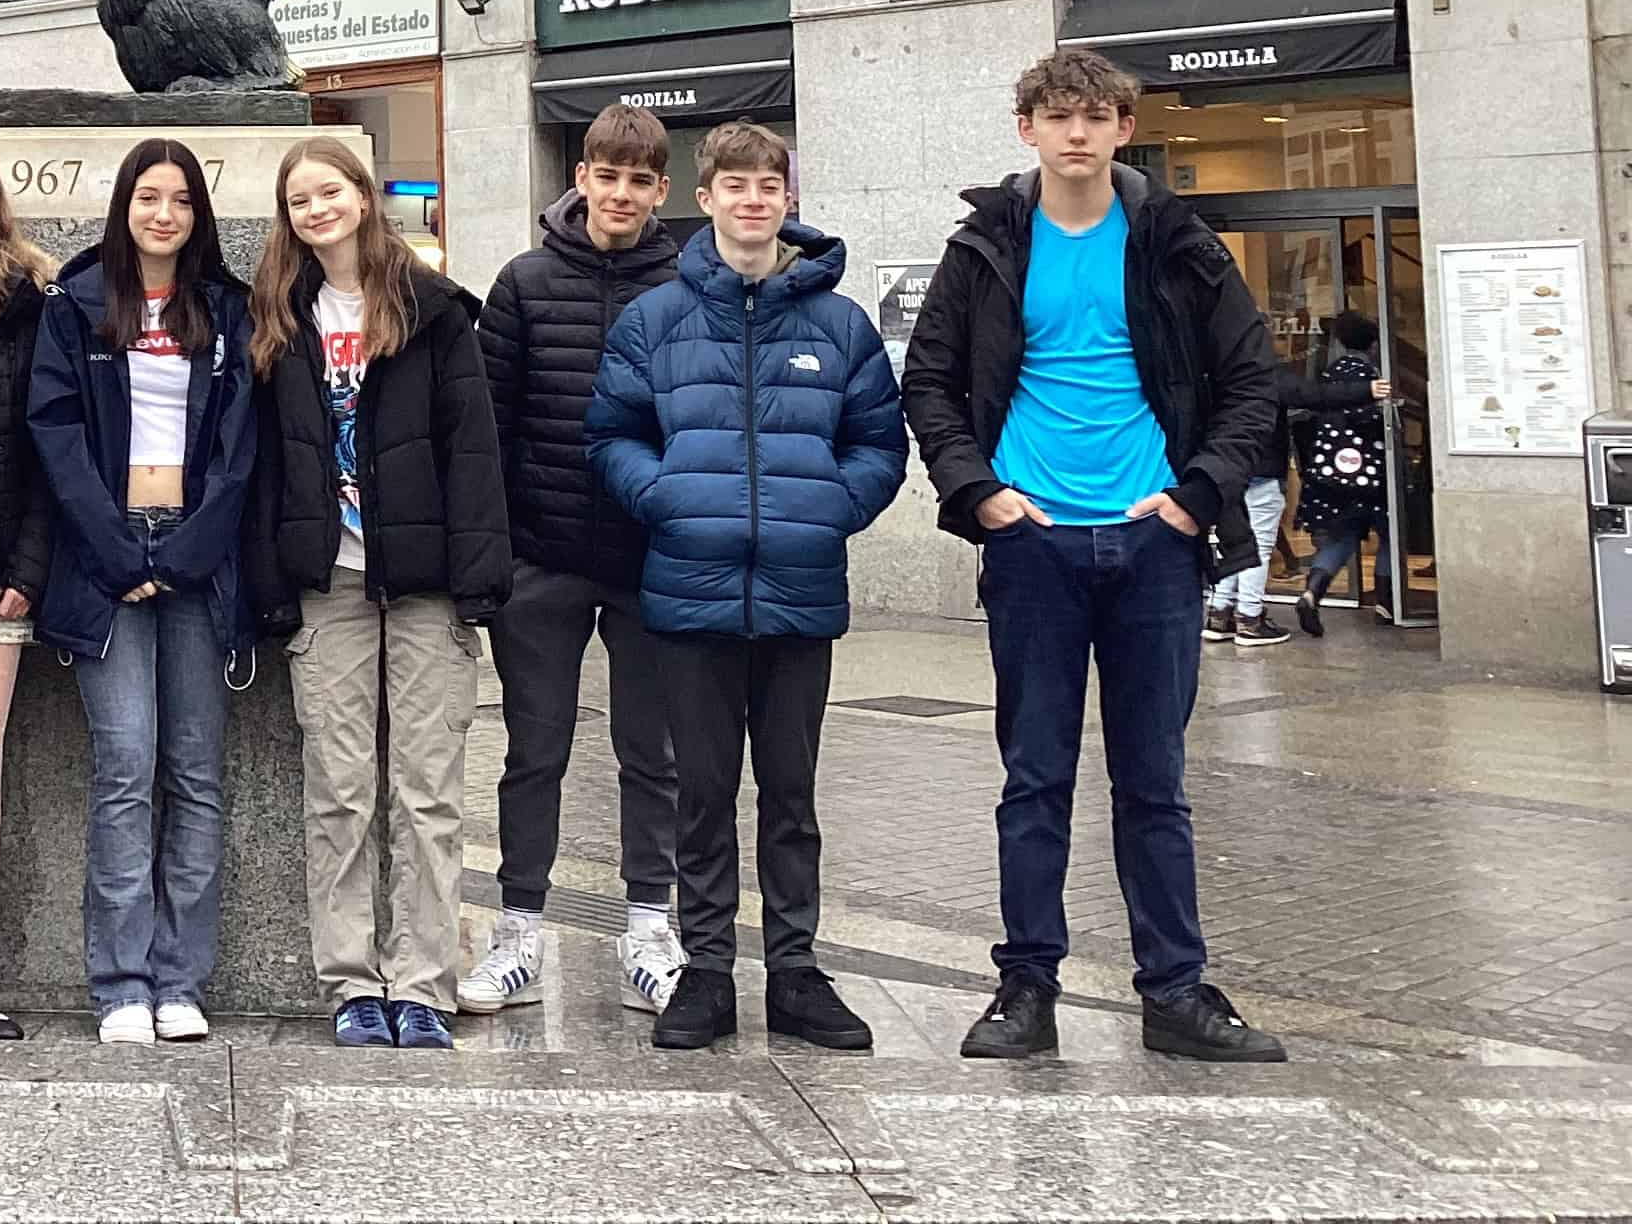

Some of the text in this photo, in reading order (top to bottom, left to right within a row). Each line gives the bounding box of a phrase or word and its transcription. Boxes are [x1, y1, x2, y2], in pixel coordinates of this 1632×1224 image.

[274, 0, 342, 22] oterías y
[343, 15, 366, 38] del
[371, 9, 430, 36] Estado
[1169, 46, 1277, 71] RODILLA
[326, 75, 343, 89] 13
[620, 89, 697, 109] RODILLA
[883, 272, 892, 285] R
